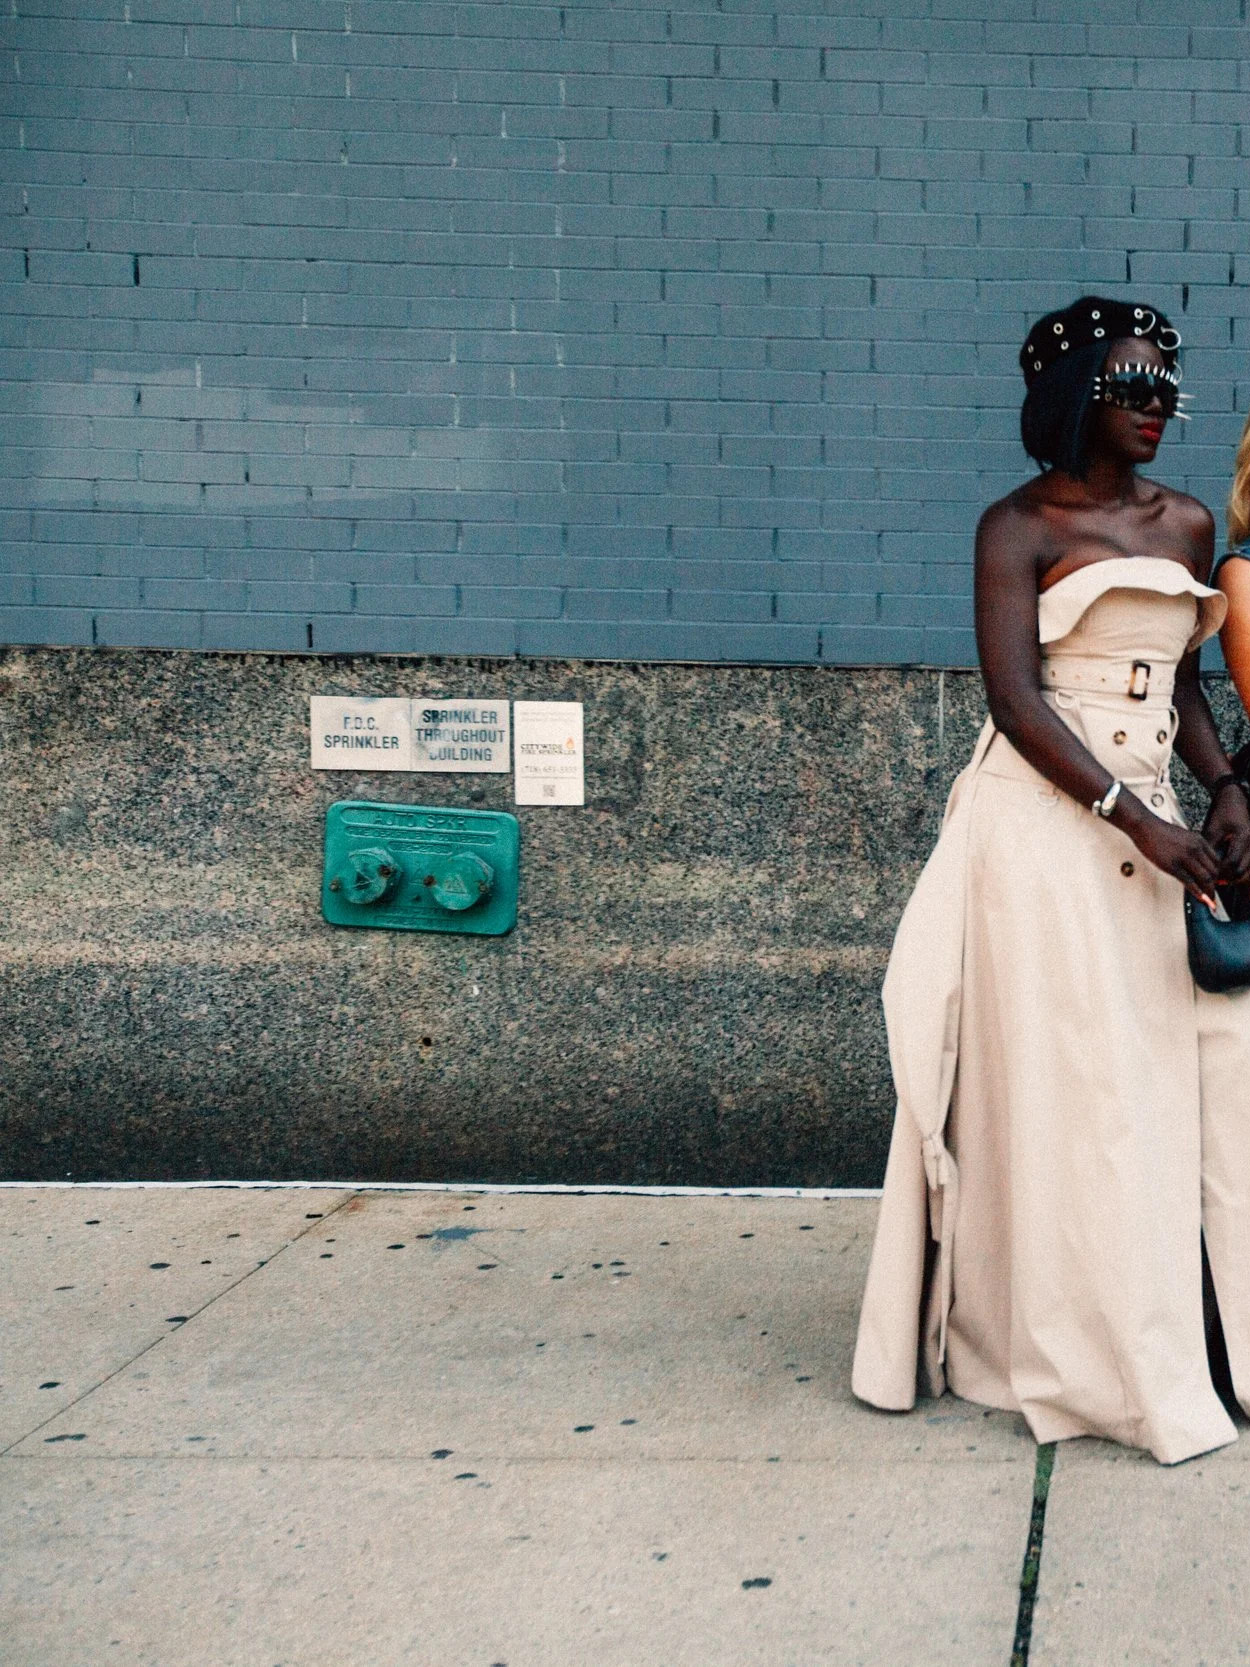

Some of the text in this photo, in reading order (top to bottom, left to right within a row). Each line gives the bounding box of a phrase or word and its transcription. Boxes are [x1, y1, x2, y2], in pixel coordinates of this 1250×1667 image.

[343, 716, 379, 730] F.D.C.
[422, 709, 498, 724] SPRINKLER
[324, 734, 399, 749] SPRINKLER
[415, 728, 506, 743] THROUGHOUT
